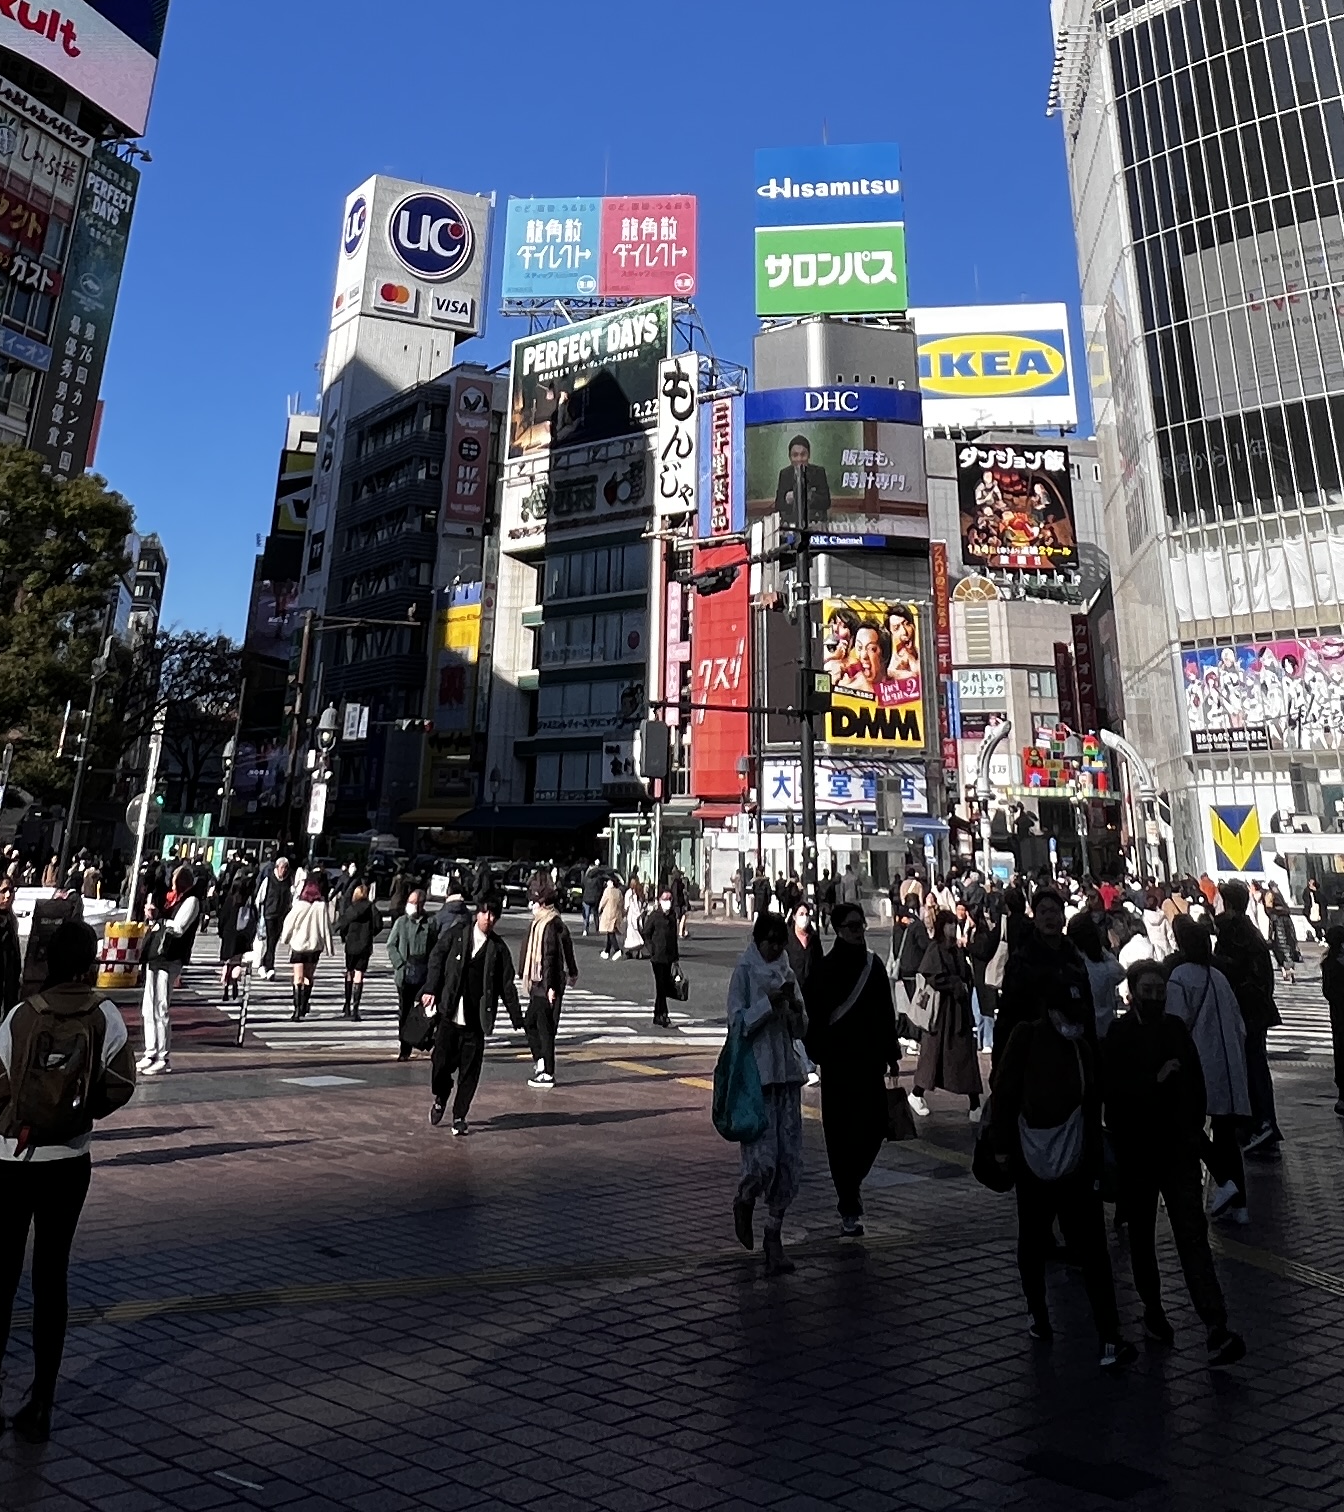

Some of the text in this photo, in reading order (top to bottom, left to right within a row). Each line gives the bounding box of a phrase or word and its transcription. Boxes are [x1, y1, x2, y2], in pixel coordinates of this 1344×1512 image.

[86, 171, 133, 213] PERFECT
[757, 177, 900, 199] Hisamitsu
[91, 196, 121, 226] DAYS
[526, 217, 582, 244] 龍角散
[621, 216, 678, 242] 龍角散
[517, 244, 592, 270] ダイレクト
[613, 243, 688, 268] ダイレクト
[764, 250, 898, 288] サロンパス
[10, 254, 54, 292] ガスト
[434, 296, 470, 317] VISA
[1249, 284, 1301, 313] LVE
[522, 312, 659, 376] PERFECT DAYS
[918, 349, 1054, 378] IKEA
[805, 391, 859, 413] DHC
[659, 358, 695, 507] もんじゃ
[958, 446, 1067, 472] ダンジョン飯
[809, 535, 864, 546] DHC Channel
[831, 705, 922, 741] DMM
